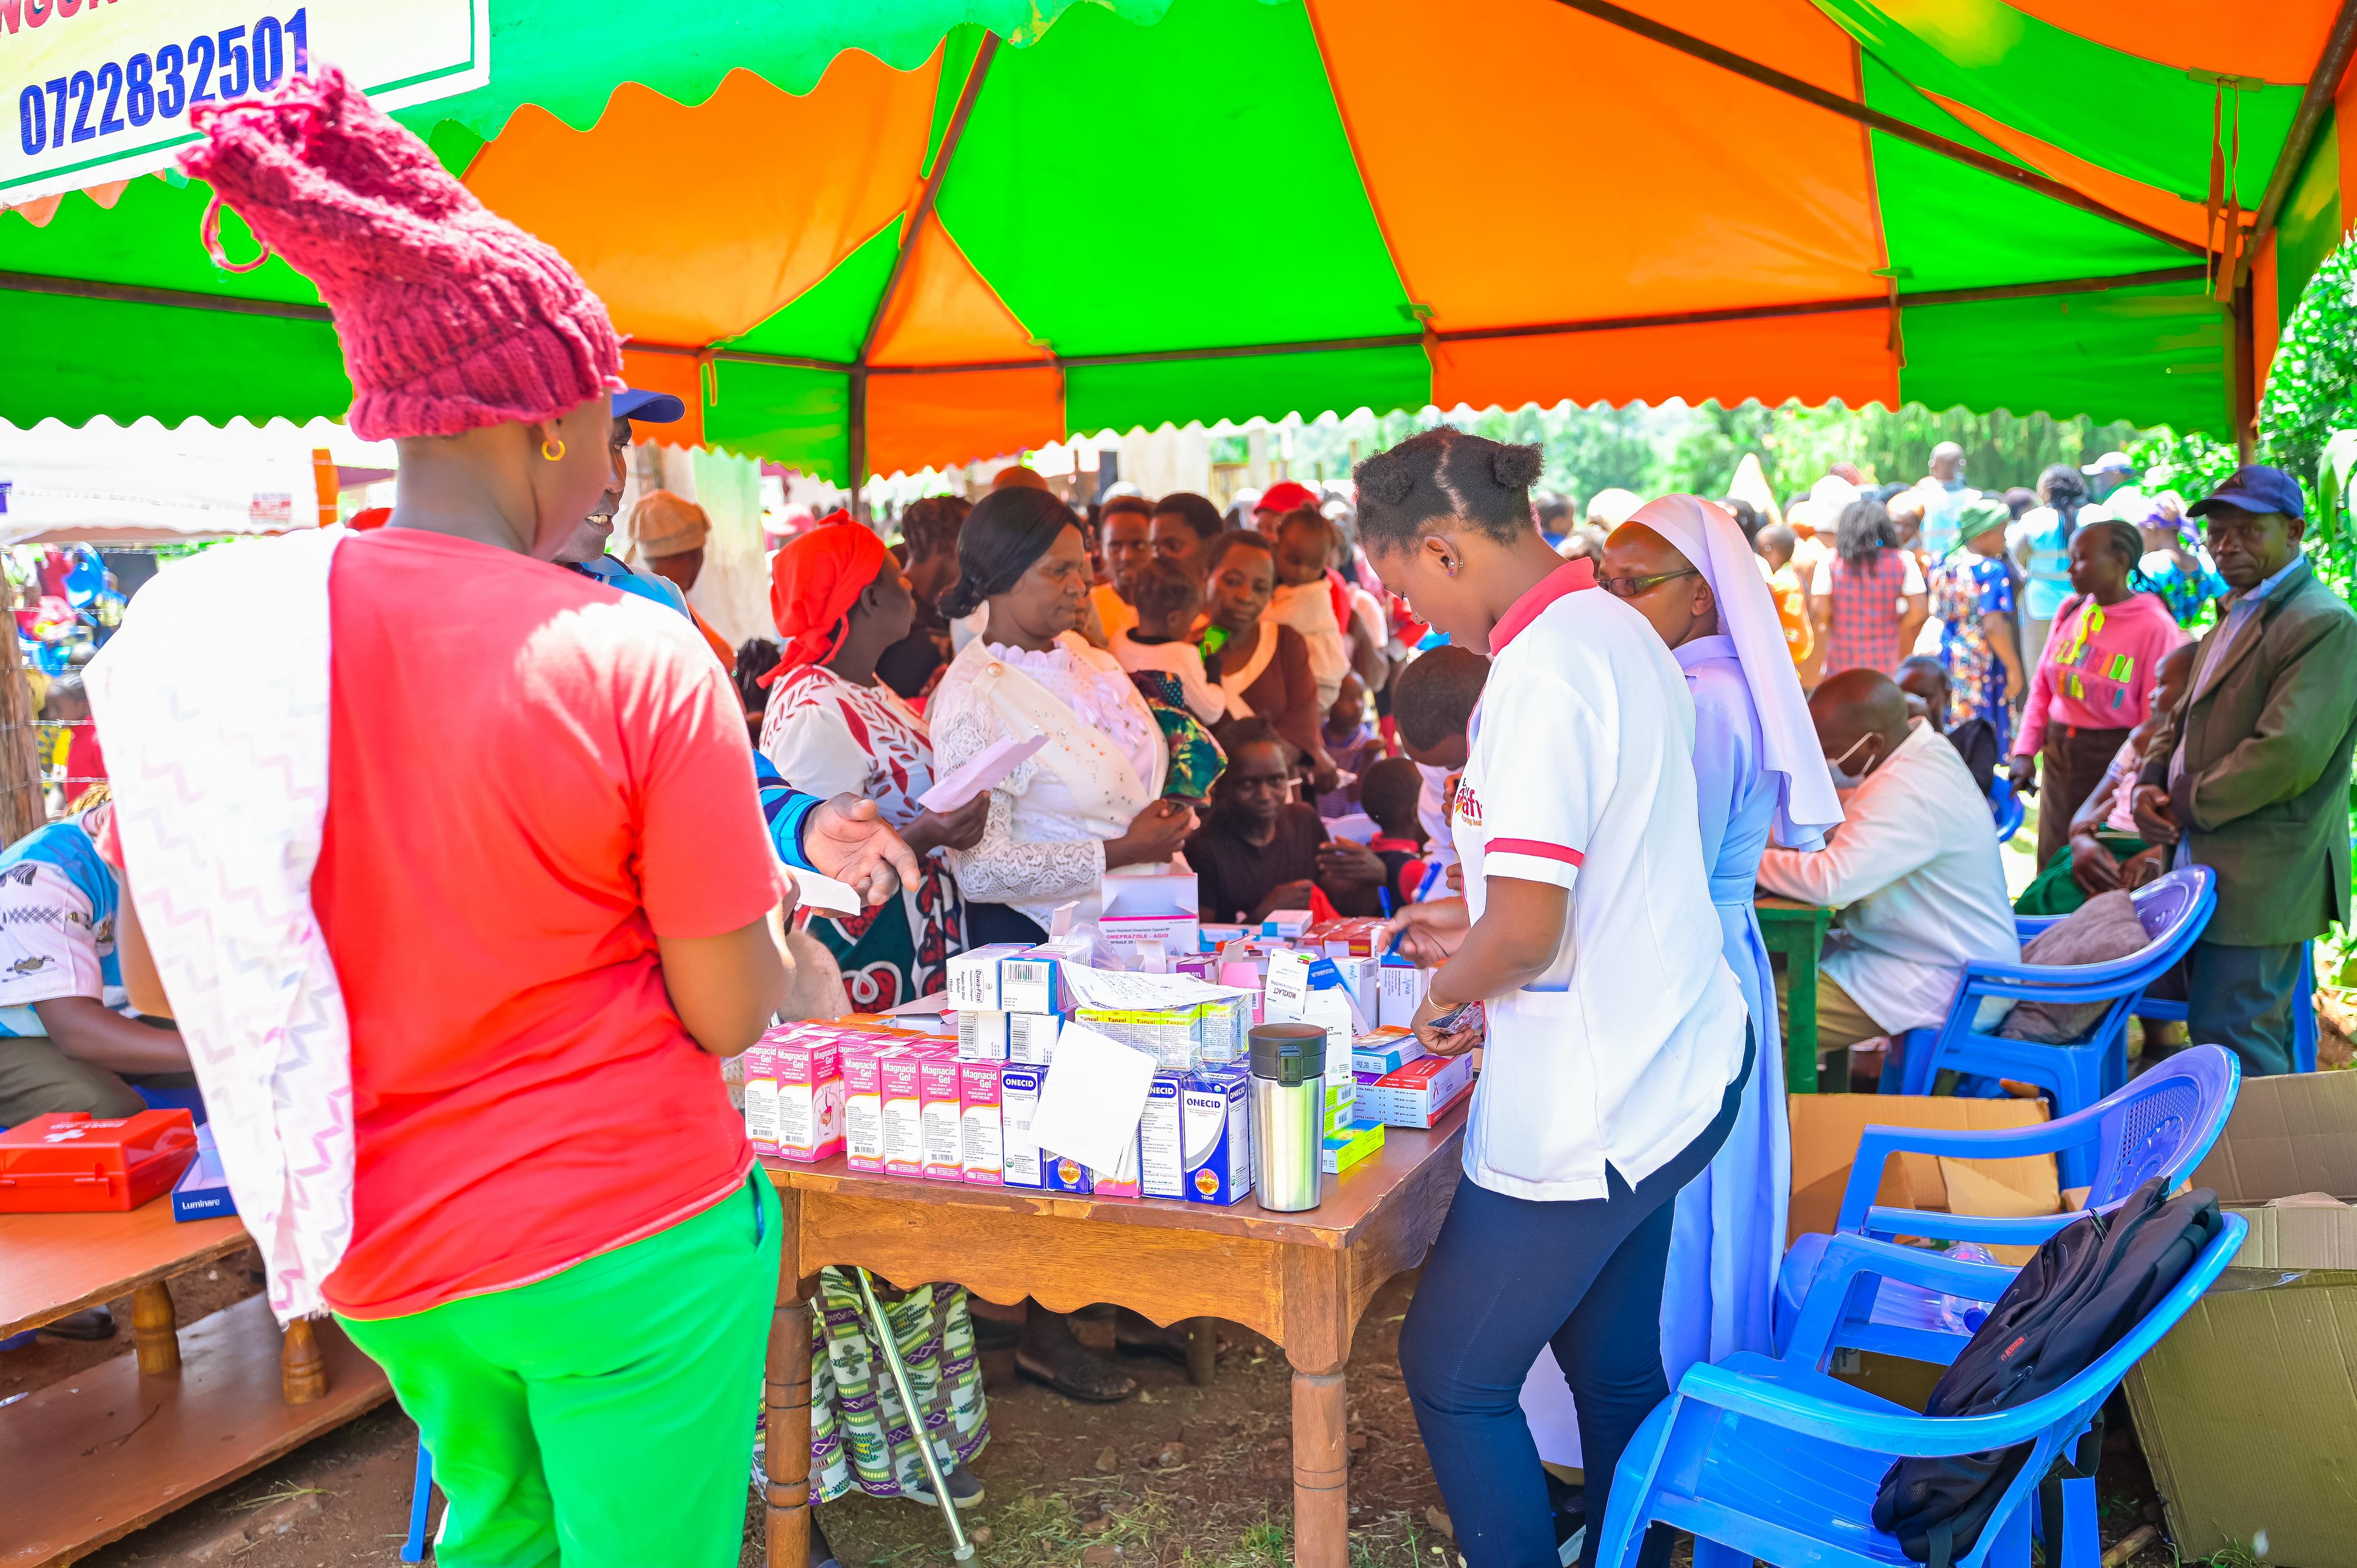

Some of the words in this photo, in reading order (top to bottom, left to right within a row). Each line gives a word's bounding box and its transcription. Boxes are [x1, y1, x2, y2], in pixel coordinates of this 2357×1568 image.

[19, 7, 309, 156] 0722832501
[1273, 987, 1296, 999] MOXILACT
[746, 1047, 776, 1056] Magnacid
[778, 1051, 809, 1062] Magnacid
[814, 1046, 837, 1061] Magnacid
[793, 1060, 804, 1069] Gel
[825, 1056, 833, 1065] Gel
[845, 1059, 877, 1070] Magnacid
[860, 1069, 871, 1077] Gel
[883, 1063, 916, 1073] Magnacid
[921, 1065, 956, 1076] Magnacid
[899, 1072, 911, 1081] Gel
[938, 1075, 951, 1084] Gel
[963, 1069, 997, 1080] Magnacid
[979, 1079, 992, 1088] Gel
[1005, 1078, 1033, 1087] ONECID
[1230, 1086, 1245, 1099] ONECID
[1186, 1098, 1220, 1108] ONECID
